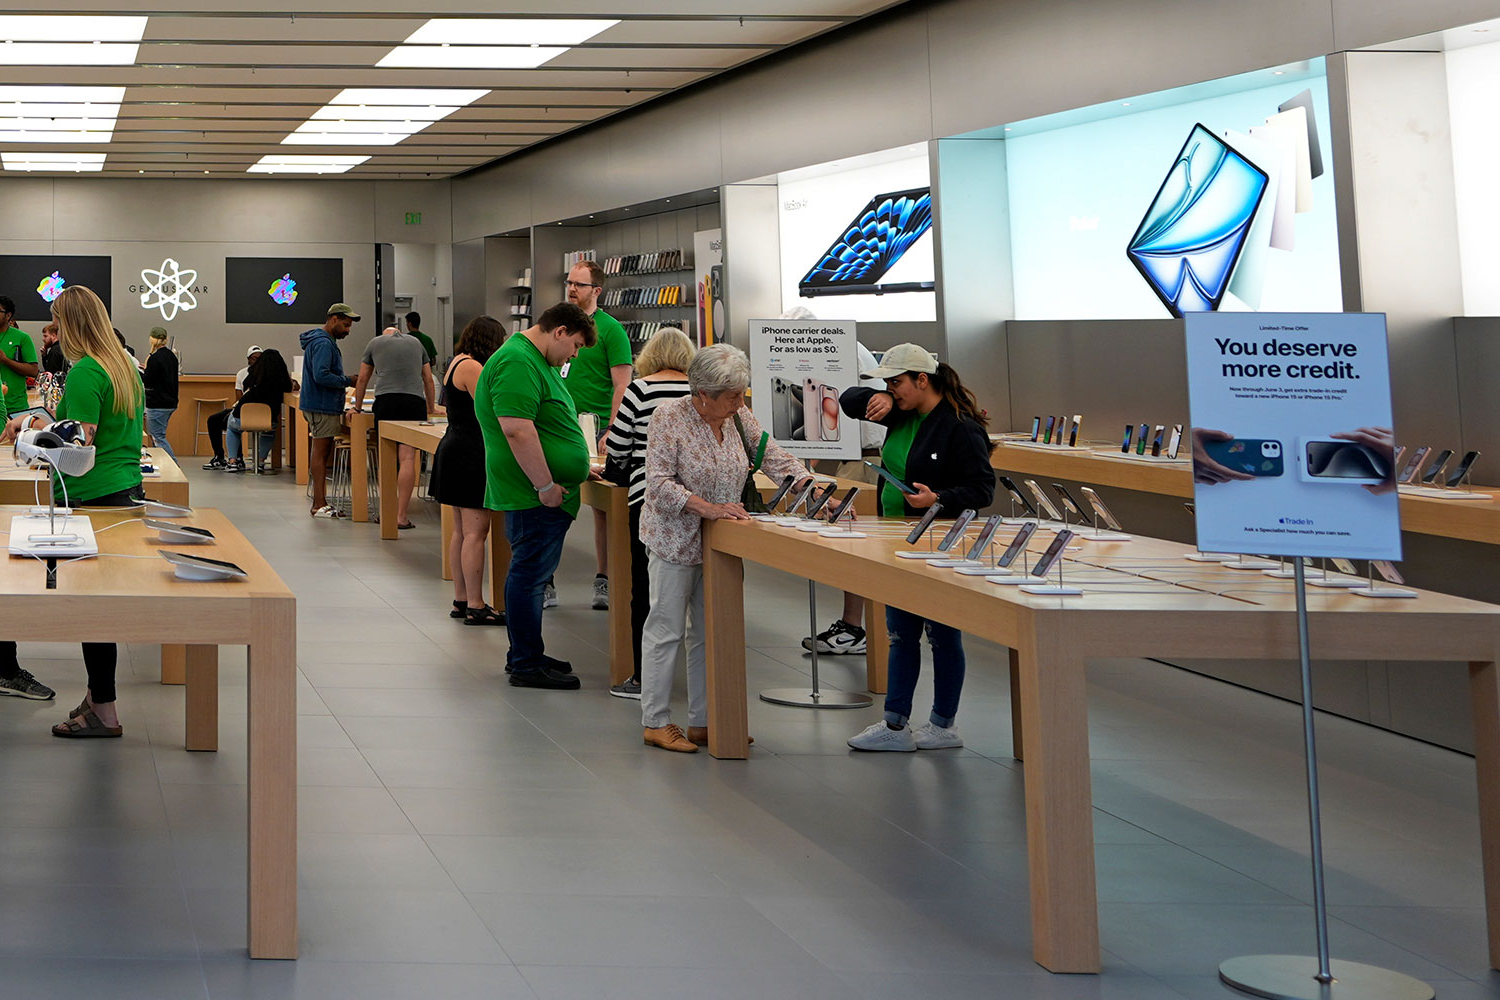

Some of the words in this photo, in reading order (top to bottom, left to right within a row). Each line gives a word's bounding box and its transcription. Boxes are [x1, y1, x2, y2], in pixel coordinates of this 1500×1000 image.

[405, 212, 422, 225] EXIT
[761, 326, 790, 335] iPhone
[792, 327, 819, 335] carrier
[821, 327, 846, 335] deals.
[807, 337, 833, 345] Apple.
[1214, 338, 1258, 356] You
[1263, 339, 1357, 357] deserve
[1222, 363, 1281, 378] more
[1286, 361, 1360, 379] credit.
